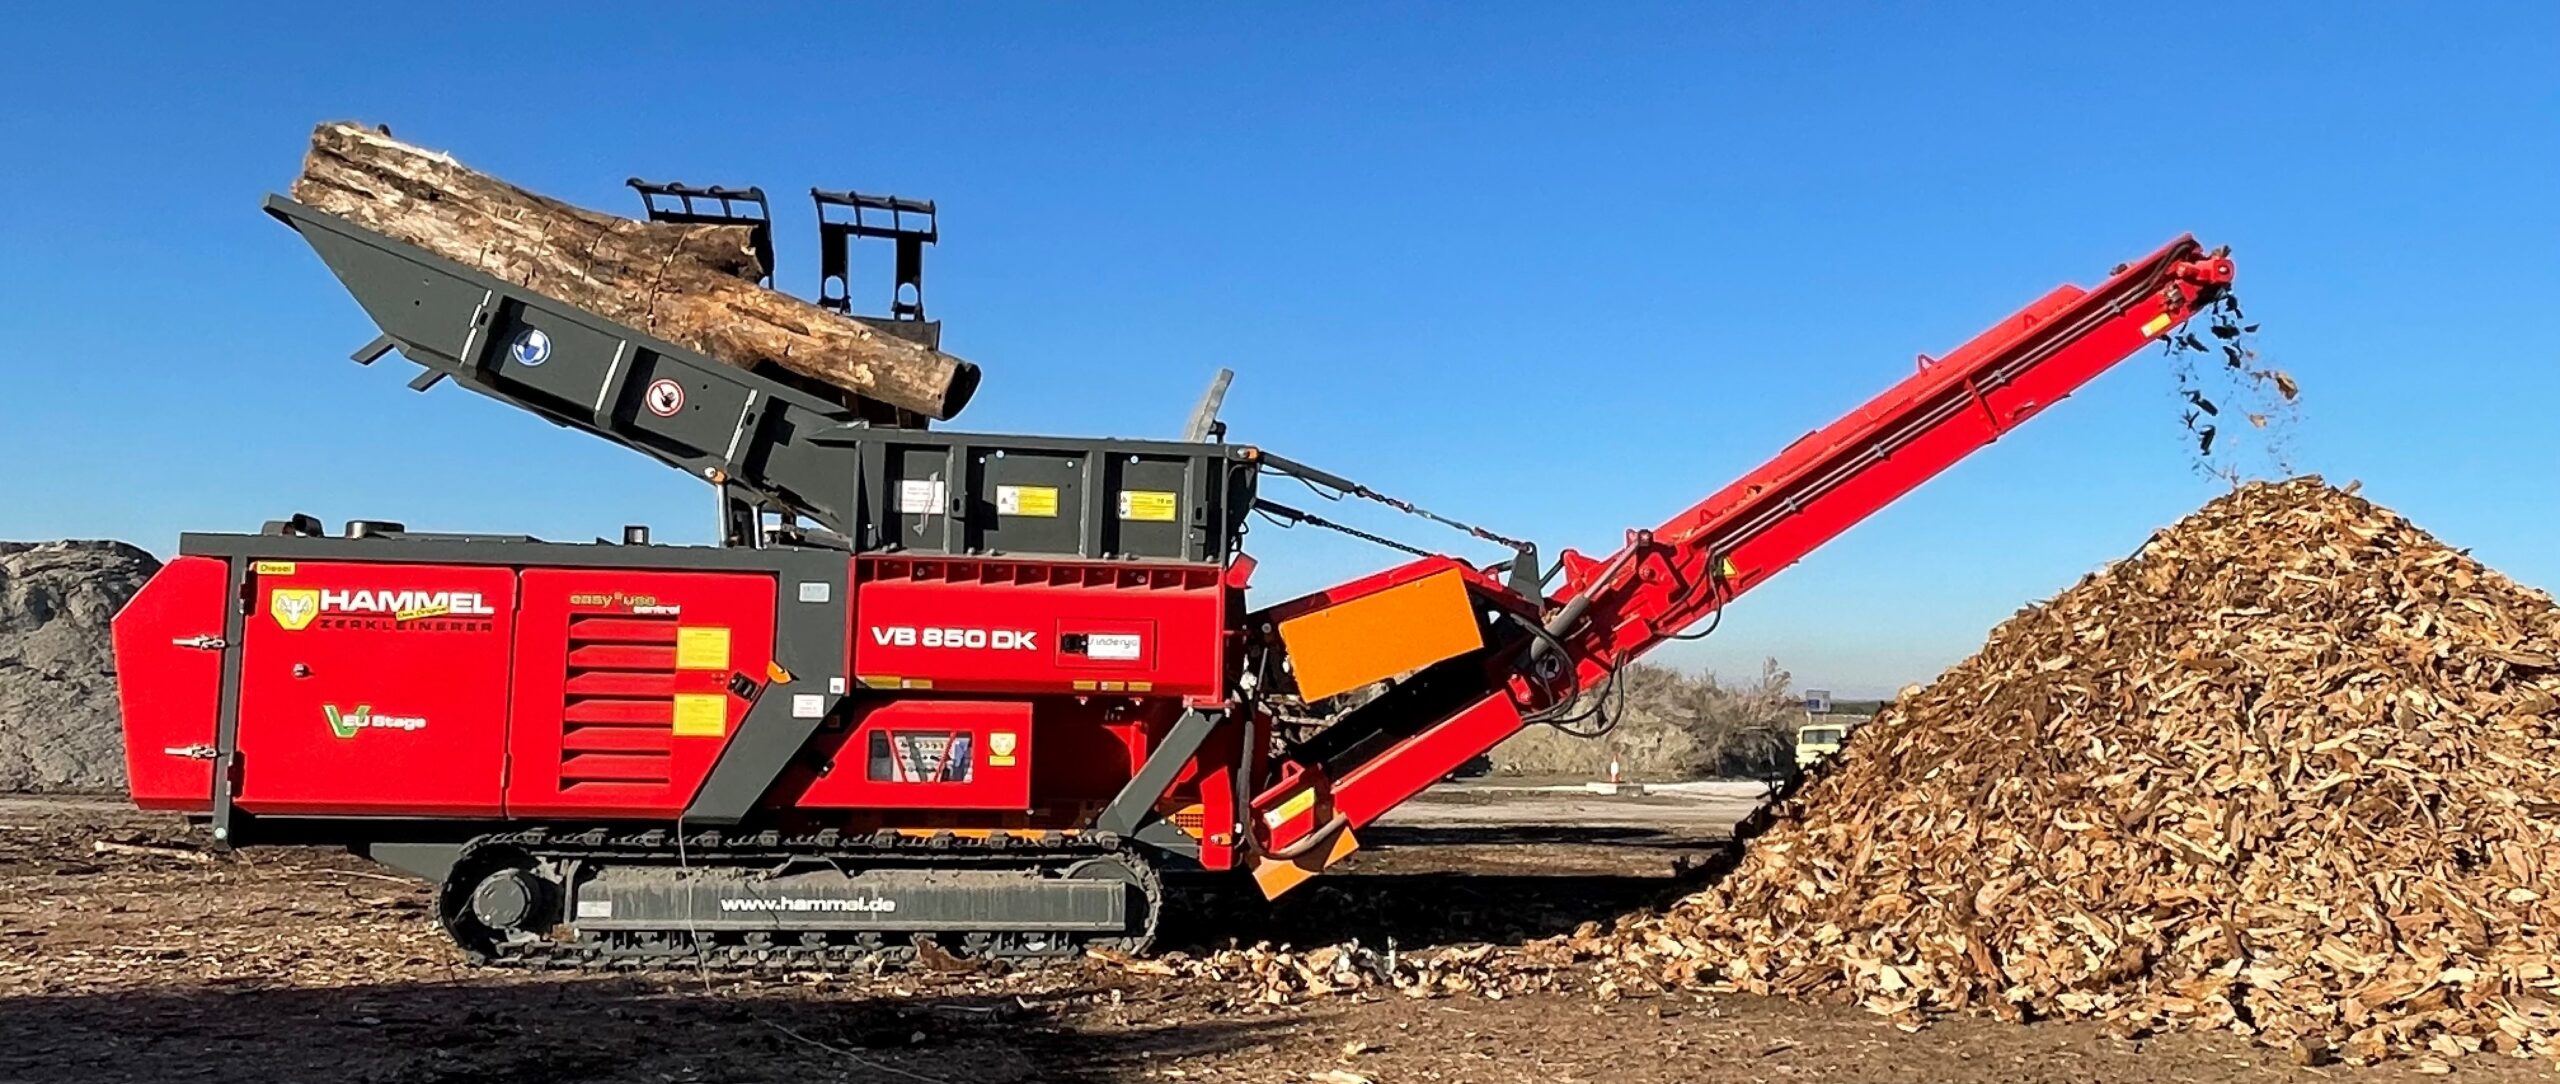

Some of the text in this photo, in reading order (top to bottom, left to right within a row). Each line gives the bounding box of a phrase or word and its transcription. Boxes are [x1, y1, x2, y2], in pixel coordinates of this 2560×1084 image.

[320, 589, 495, 615] HAMMEL
[319, 619, 493, 632] ZERKLEINERER
[871, 626, 1037, 651] VB 850 DK
[372, 714, 427, 731] Stage
[720, 896, 897, 912] www.hammel.de
